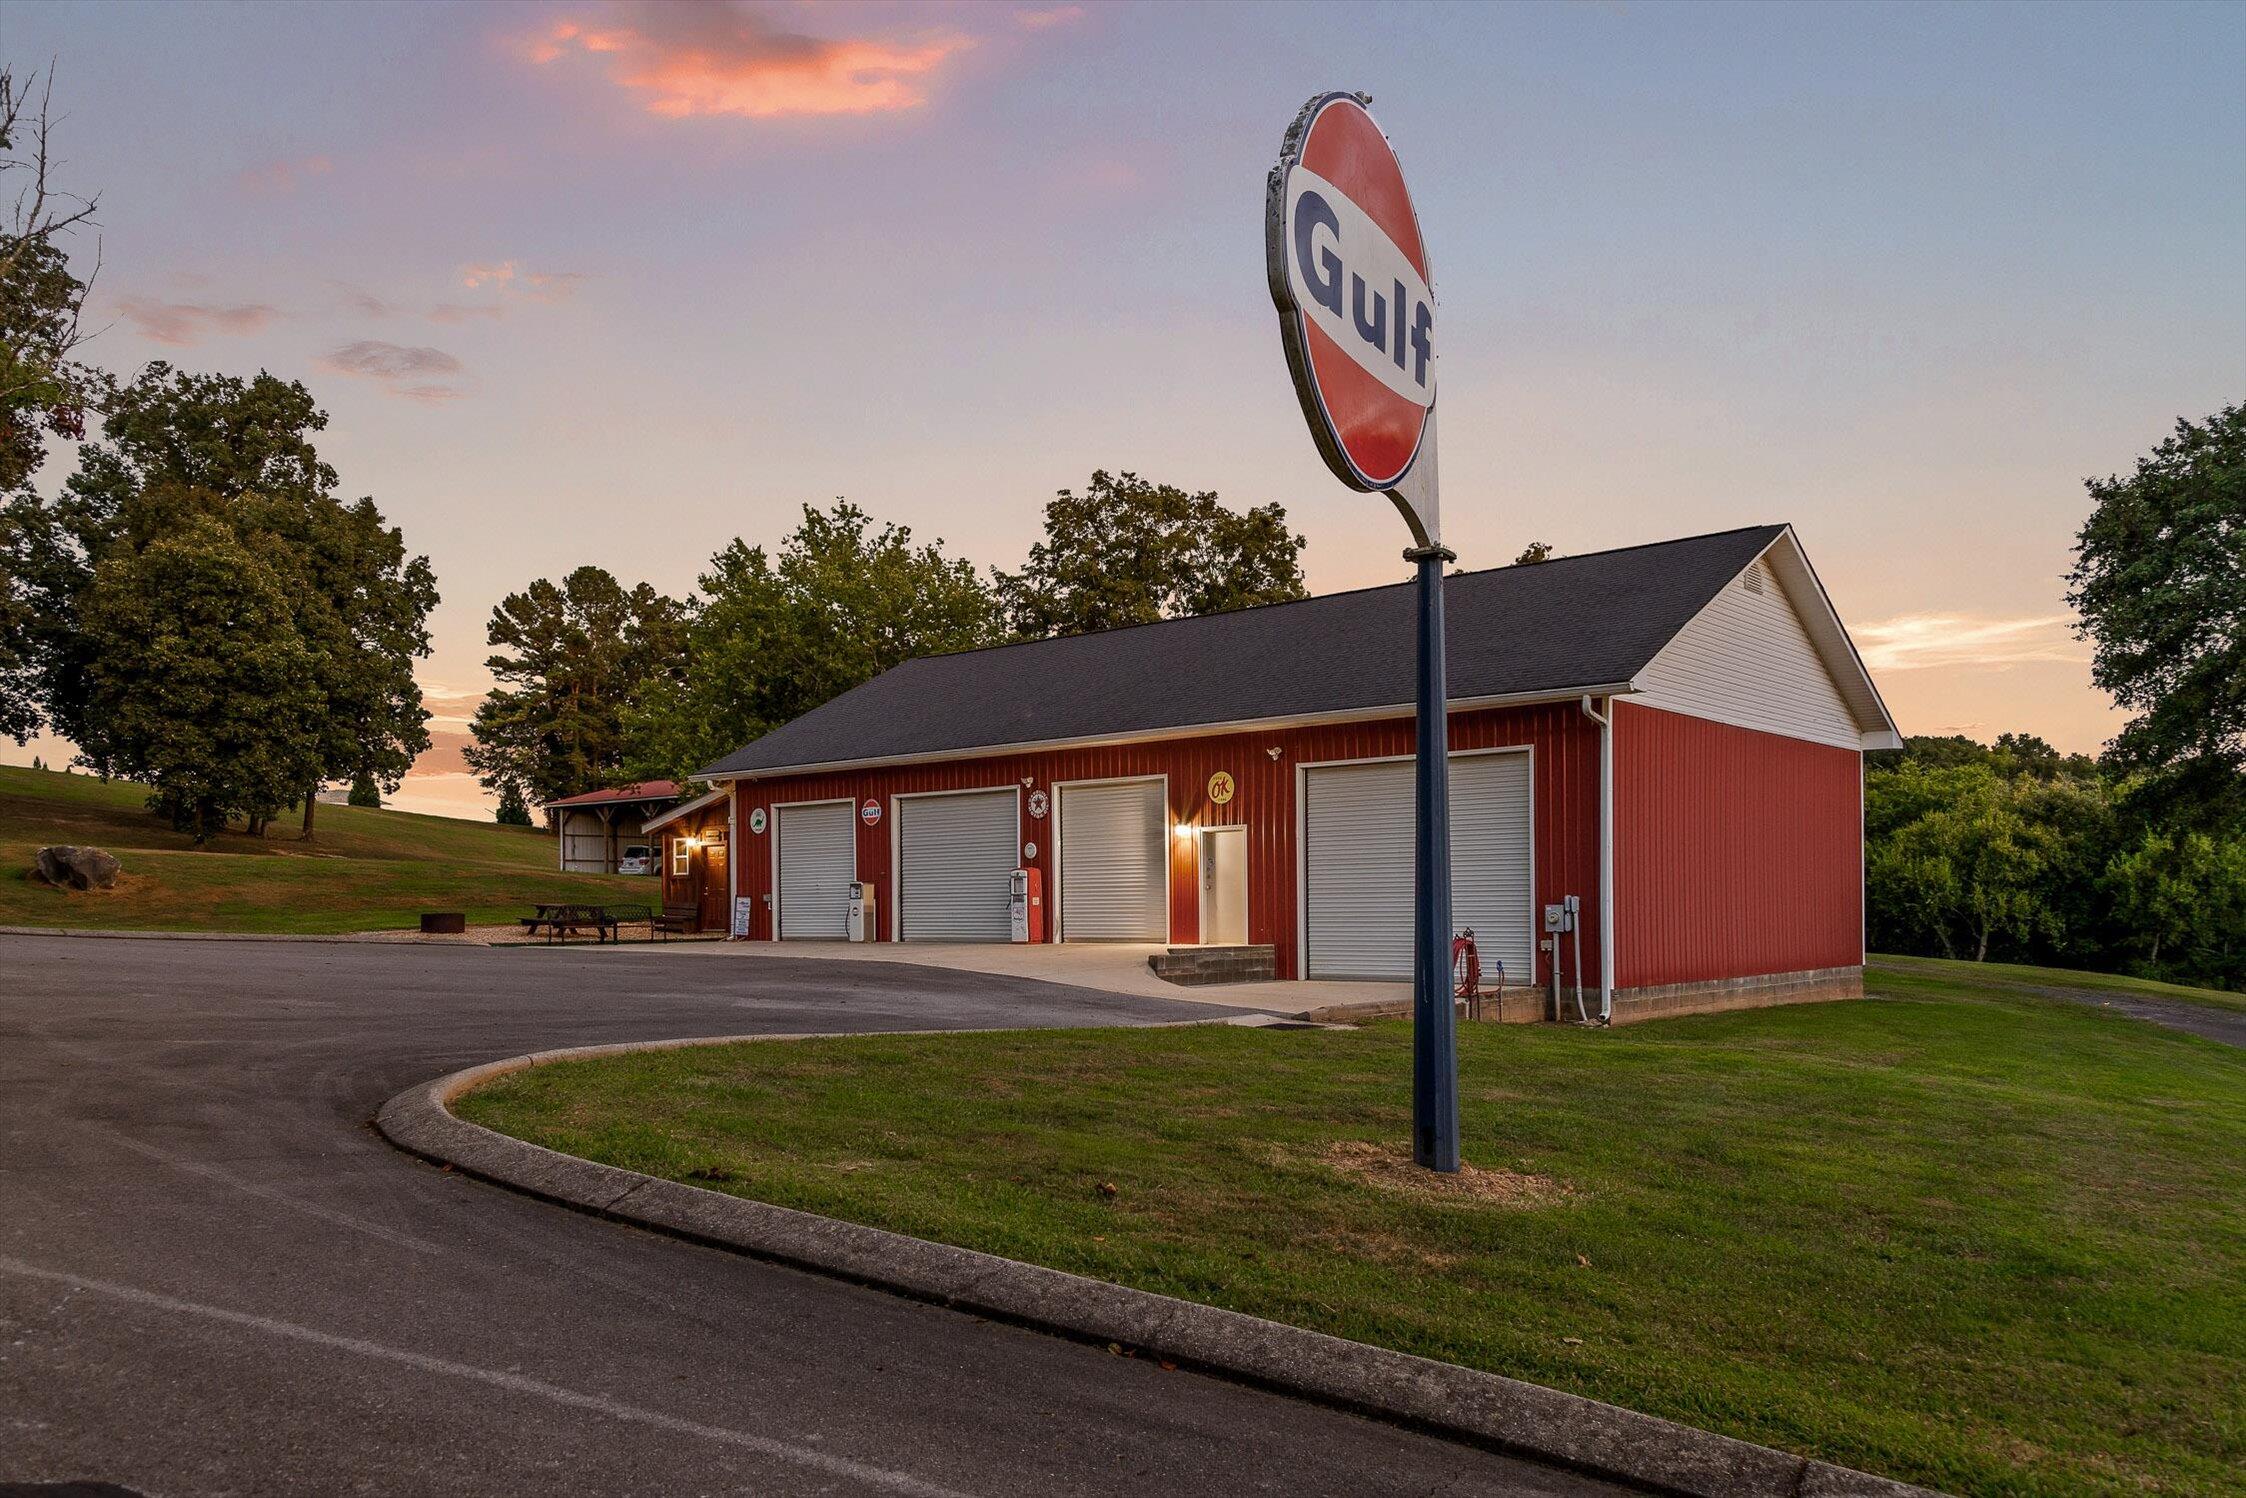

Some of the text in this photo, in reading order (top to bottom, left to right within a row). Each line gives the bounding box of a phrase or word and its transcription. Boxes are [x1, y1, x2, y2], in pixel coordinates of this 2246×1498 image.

[1294, 190, 1432, 389] Gulf
[1212, 776, 1230, 798] OK
[863, 808, 880, 817] Gulf
